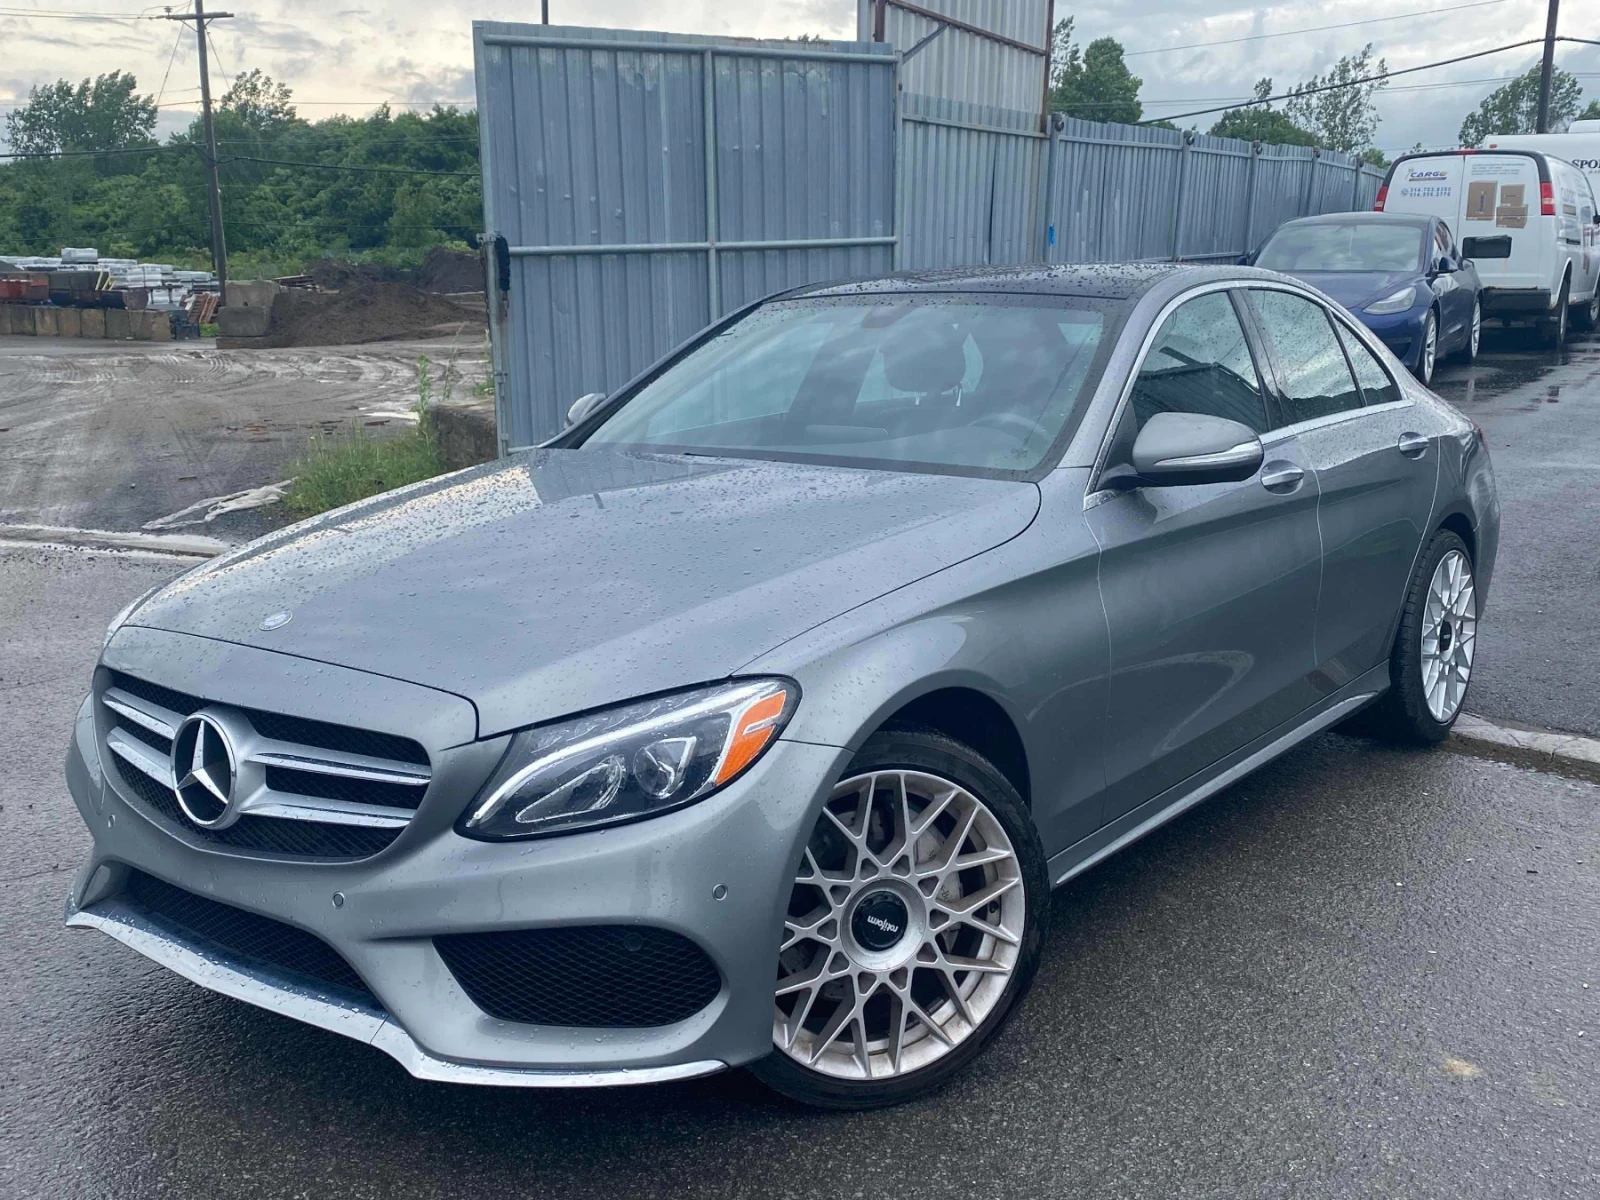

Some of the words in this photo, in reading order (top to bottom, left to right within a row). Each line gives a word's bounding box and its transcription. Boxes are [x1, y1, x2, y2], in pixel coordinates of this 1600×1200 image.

[1572, 158, 1600, 169] SPO
[1410, 170, 1448, 178] CARGO
[867, 915, 899, 933] rotiform
